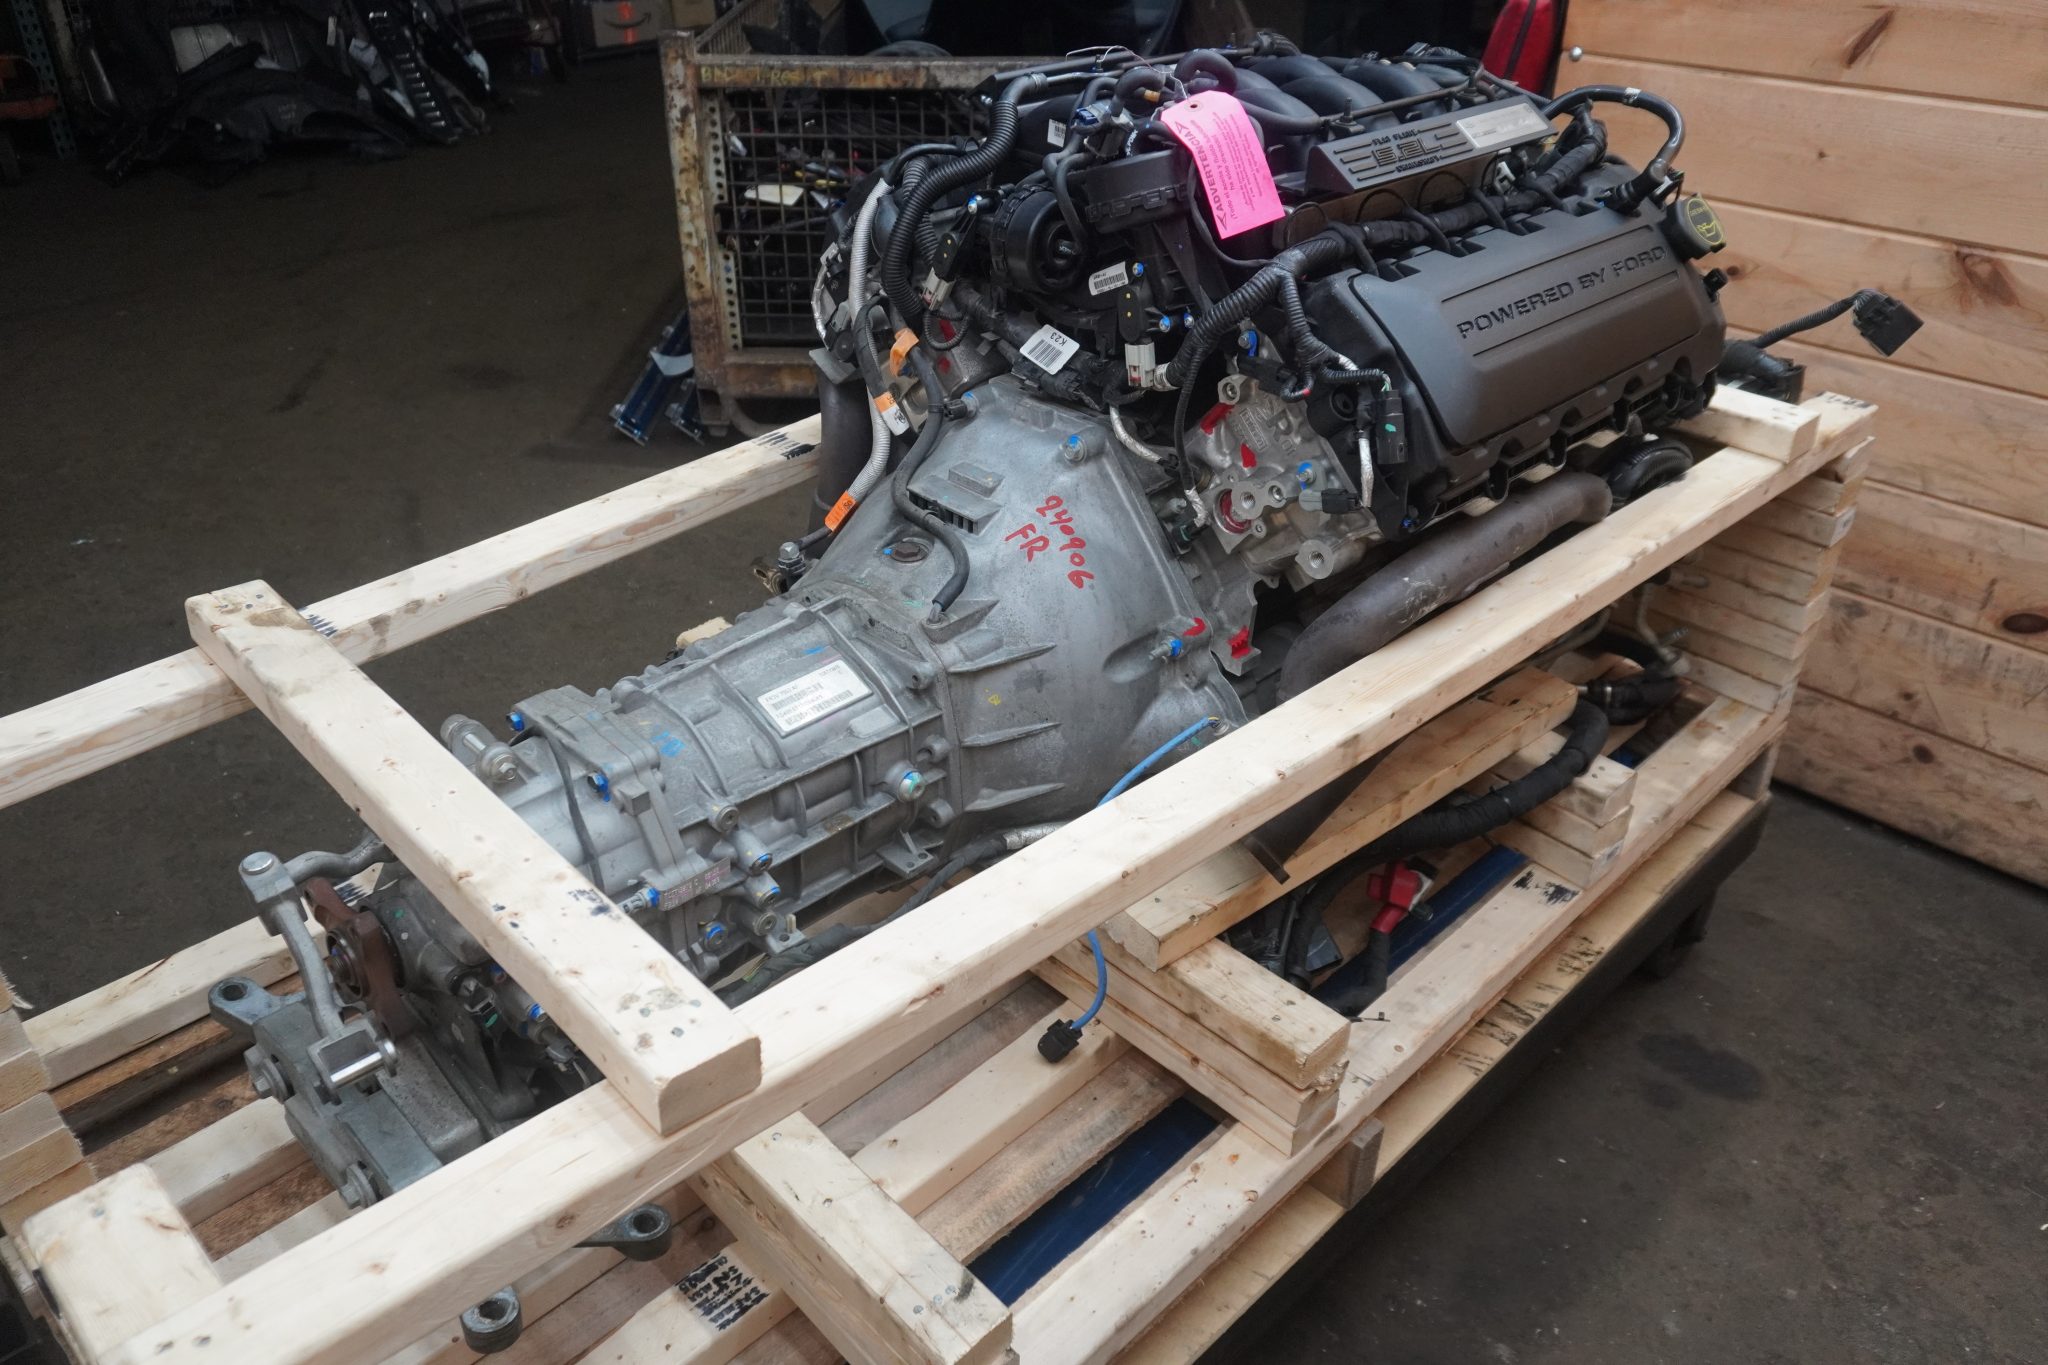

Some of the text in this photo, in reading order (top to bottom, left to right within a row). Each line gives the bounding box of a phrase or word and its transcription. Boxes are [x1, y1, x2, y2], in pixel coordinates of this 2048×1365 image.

[1184, 130, 1225, 211] ADVERTENCIA
[1372, 138, 1442, 167] 5.2L
[1456, 245, 1669, 339] POWERED BY FORD
[1049, 331, 1068, 347] K23
[1004, 523, 1050, 562] FR
[1035, 495, 1095, 589] 240906
